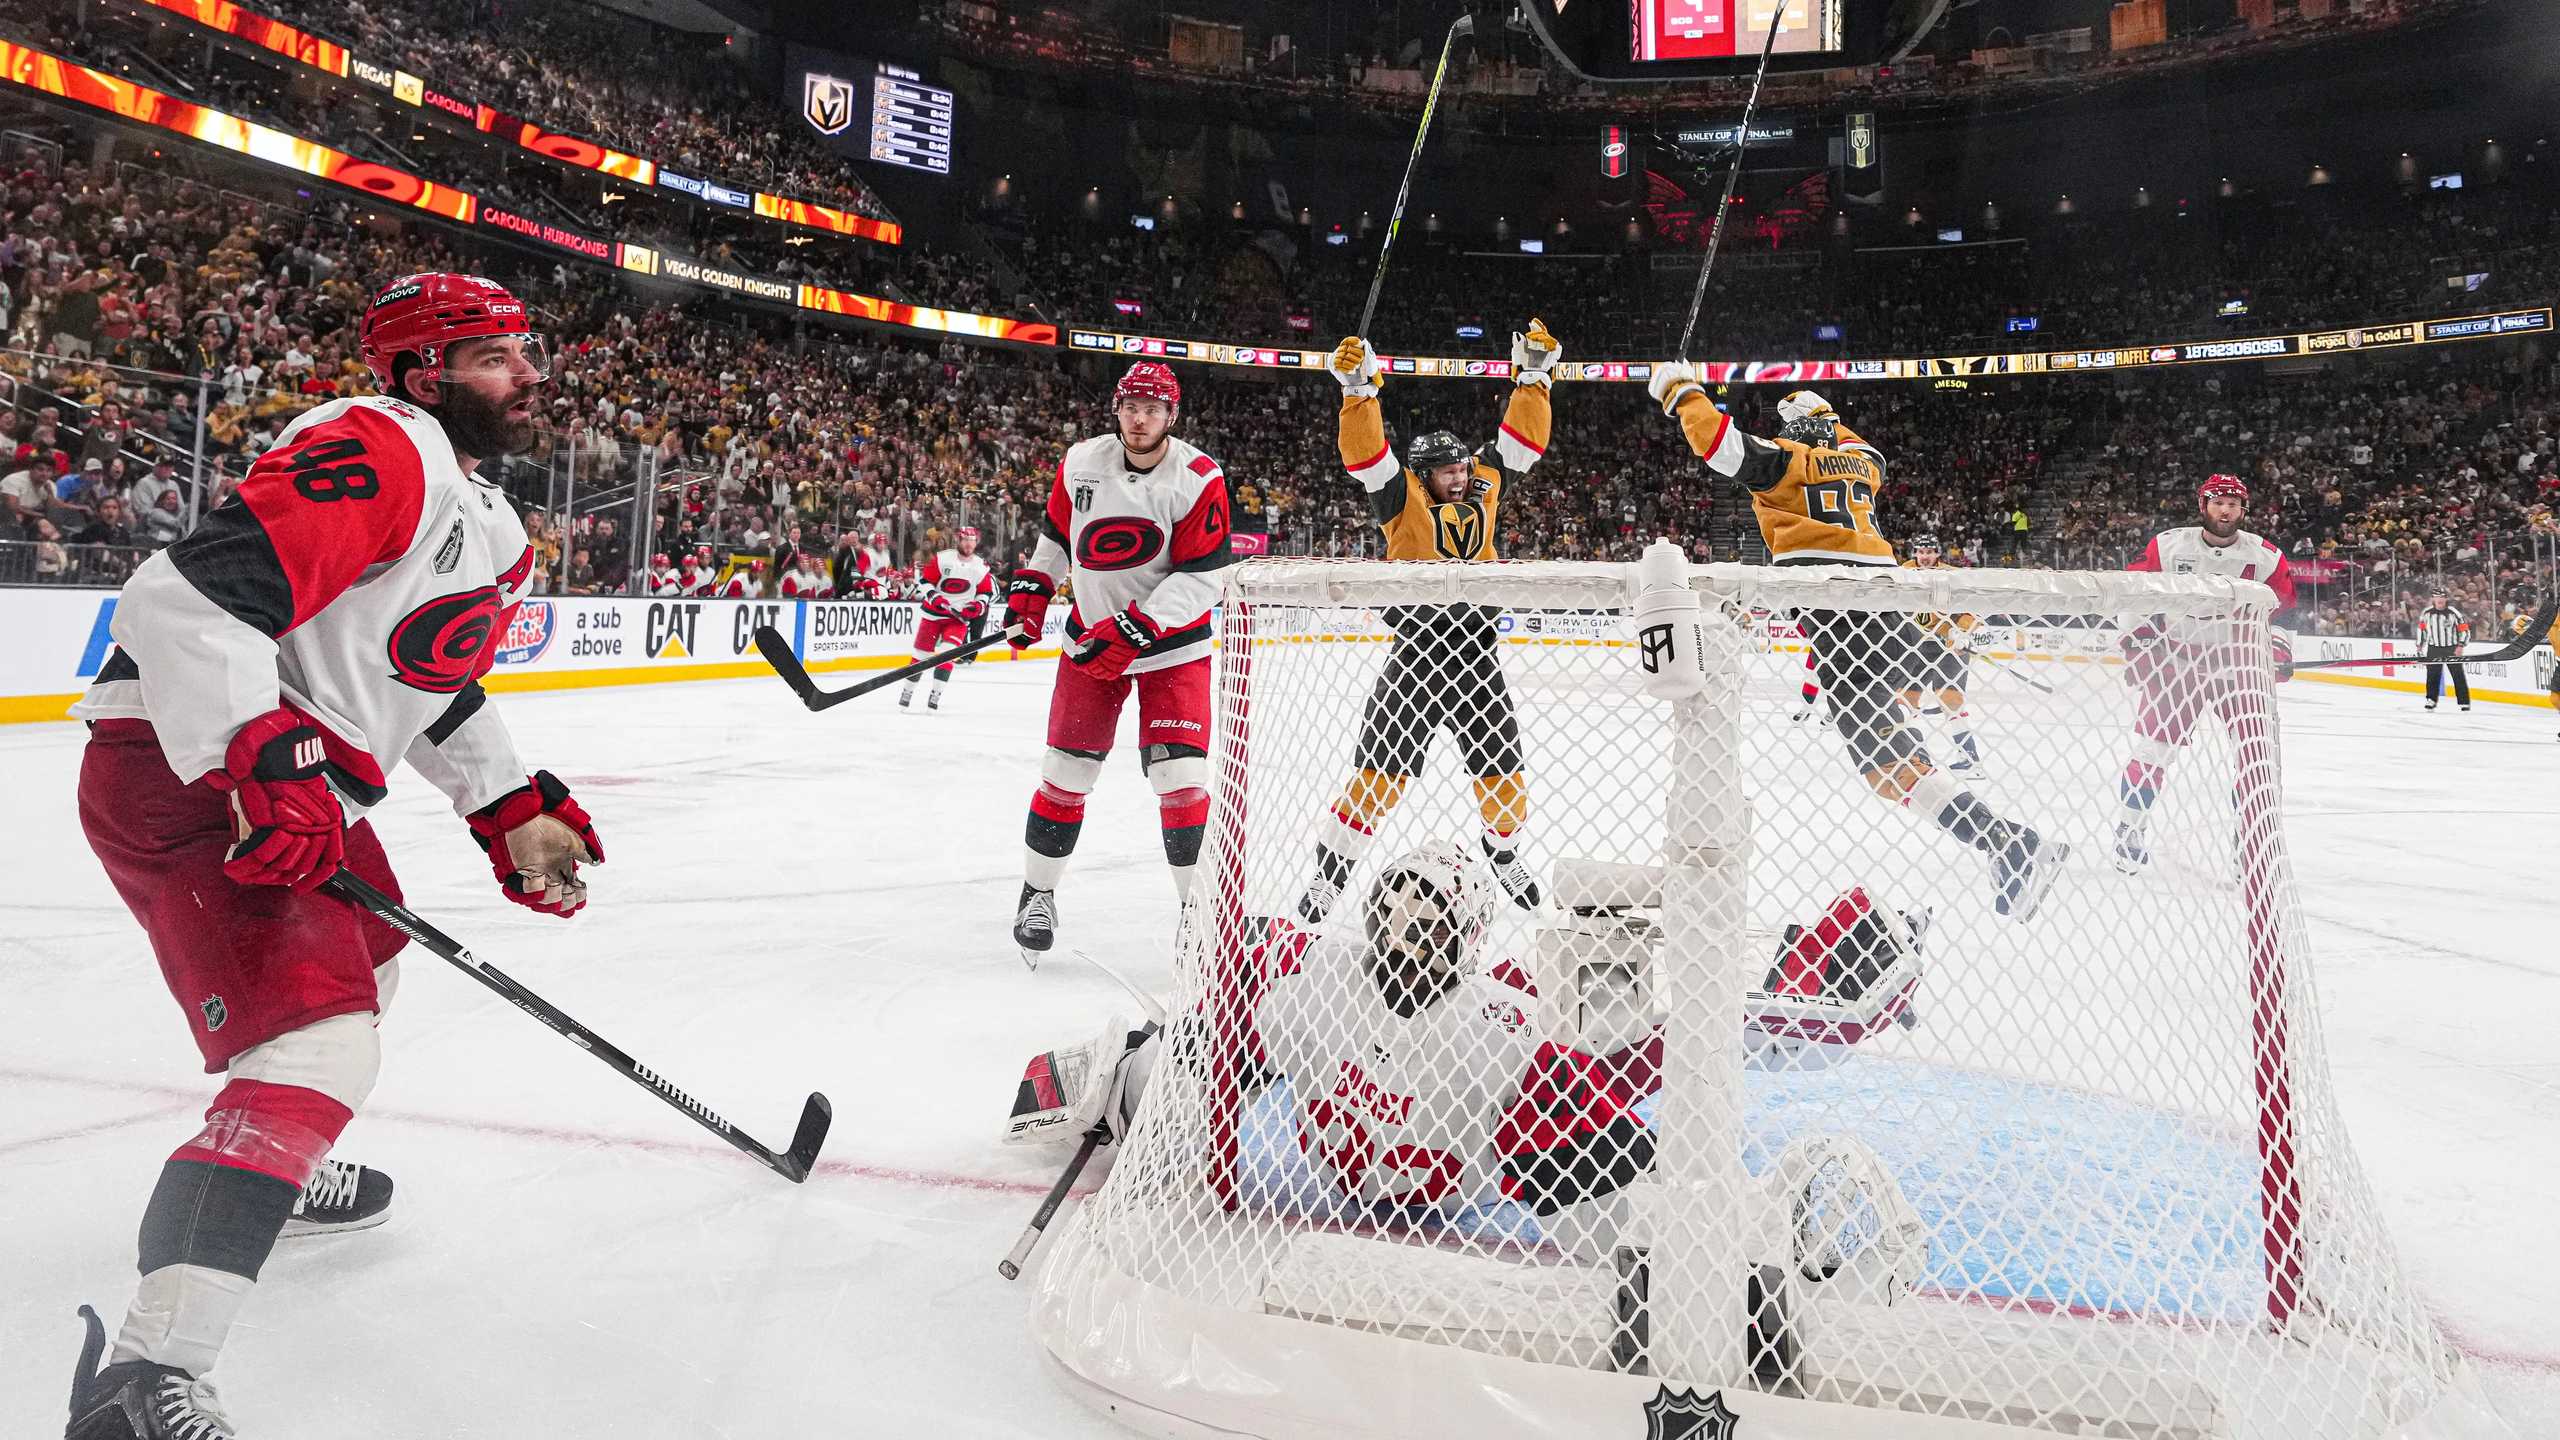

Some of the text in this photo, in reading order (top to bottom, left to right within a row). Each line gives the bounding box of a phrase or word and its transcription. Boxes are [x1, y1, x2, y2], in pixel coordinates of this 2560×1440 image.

[352, 60, 392, 88] VEGAS
[424, 90, 474, 120] CAROLINA
[1678, 132, 1714, 142] STANLEY
[1715, 132, 1732, 140] CUP
[483, 207, 609, 258] CAROLINA HURRICANES
[630, 253, 643, 265] VS
[664, 259, 792, 300] VEGAS GOLDEN KNIGHTS
[375, 285, 421, 306] Lenovo
[491, 304, 521, 314] CCM
[2436, 324, 2472, 335] STANLEY
[2472, 322, 2490, 331] CUP
[2502, 318, 2529, 328] FINAL
[2308, 329, 2401, 349] Forged in Gold
[1489, 363, 1509, 375] 1/2
[1851, 361, 1882, 373] 14:22
[2115, 350, 2150, 366] RAFFLE
[1140, 366, 1155, 376] 21
[1816, 438, 1829, 449] 93
[1815, 455, 1871, 480] MARNER
[1803, 479, 1883, 538] 93
[577, 606, 622, 629] a sub
[814, 605, 913, 637] BODYARMOR
[646, 603, 701, 659] CAT
[733, 604, 781, 656] CAT
[1112, 610, 1152, 648] CCM
[572, 633, 622, 657] above
[813, 641, 859, 652] SPORTS DRINK
[1693, 623, 1706, 672] BODYARMOR
[506, 650, 529, 663] SUBS
[1150, 718, 1202, 733] BAUER
[376, 910, 430, 944] WARRIOR
[512, 998, 540, 1020] ALPHA
[633, 1060, 733, 1134] WARRIOR
[1010, 1113, 1069, 1133] TRUE
